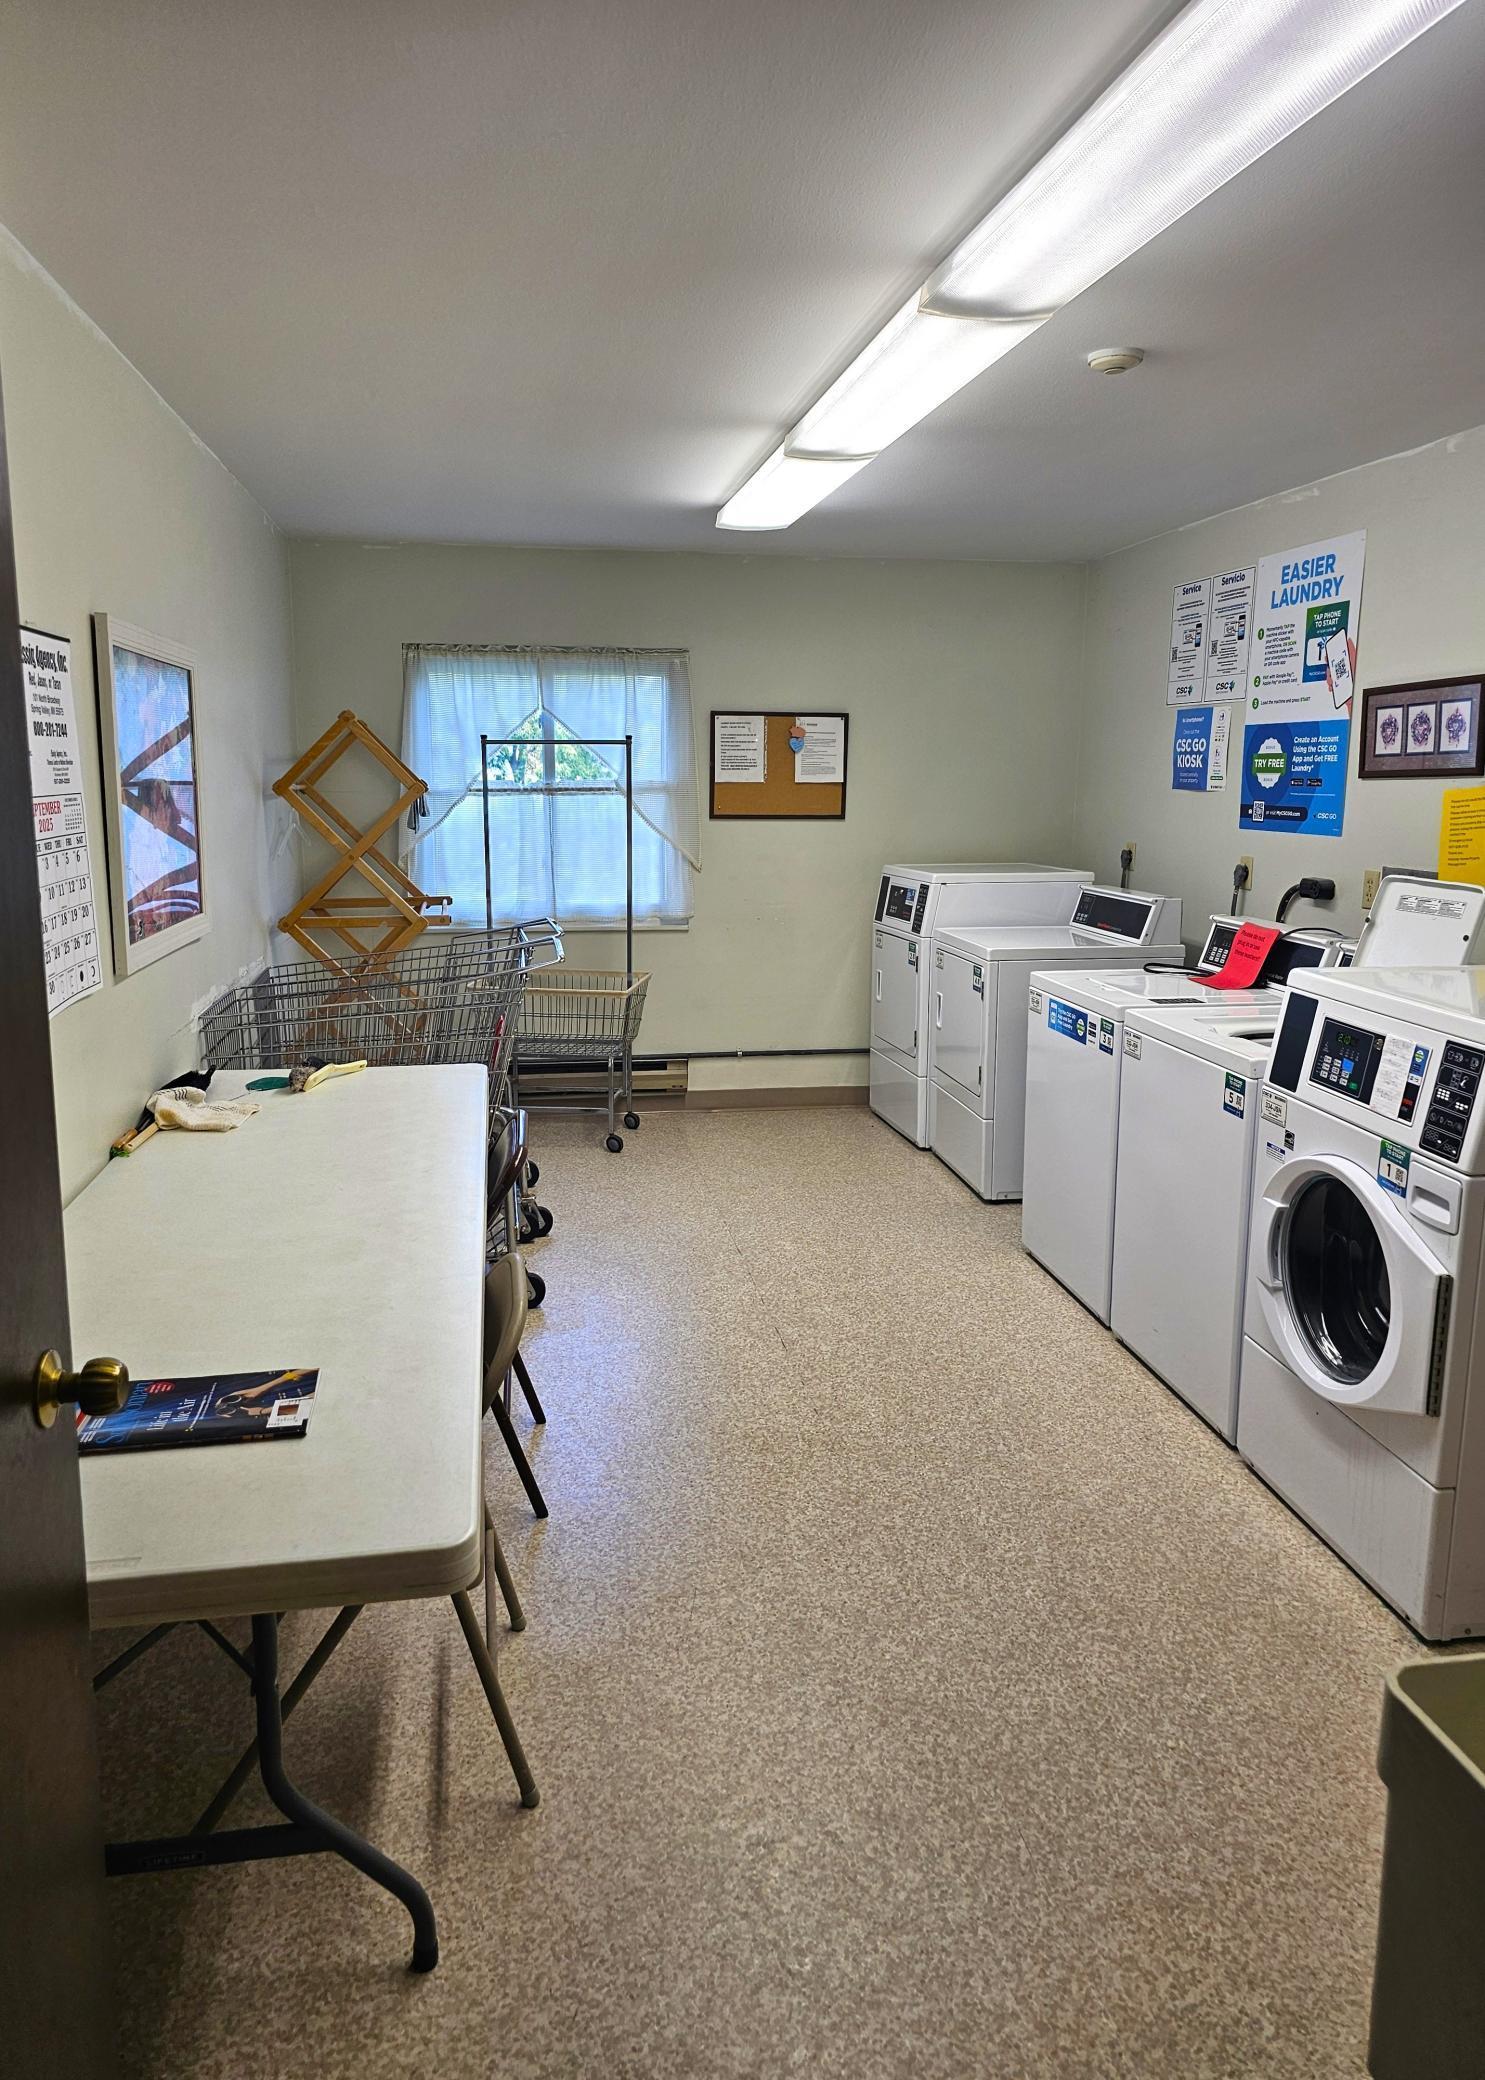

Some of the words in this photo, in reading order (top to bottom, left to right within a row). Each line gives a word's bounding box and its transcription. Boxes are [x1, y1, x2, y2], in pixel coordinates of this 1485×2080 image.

[1281, 553, 1336, 584] EASIER
[1221, 572, 1246, 586] Servicio
[1182, 584, 1202, 596] Service
[1271, 575, 1344, 609] LAUNDRY
[1324, 609, 1341, 619] PHONE
[1315, 620, 1322, 628] TO
[1322, 617, 1339, 626] START
[1176, 686, 1188, 695] CSC
[1216, 682, 1229, 690] CSC
[1176, 738, 1192, 752] CSC
[1192, 738, 1206, 752] GO
[1177, 754, 1203, 768] KIOSK
[1254, 759, 1266, 768] TRY
[1268, 758, 1284, 768] FREE
[39, 818, 53, 832] 2025
[44, 841, 52, 851] WED
[45, 857, 49, 870] 3
[56, 854, 59, 868] 4
[66, 852, 69, 864] 5
[76, 850, 80, 862] 6
[48, 886, 55, 900] 10
[59, 884, 64, 896] 11
[69, 880, 75, 893] 12
[80, 878, 86, 890] 13
[51, 916, 56, 930] 17
[61, 912, 67, 926] 18
[71, 908, 78, 922] 19
[82, 905, 89, 918] 20
[45, 950, 51, 964] 23
[54, 945, 60, 960] 24
[64, 940, 70, 954] 25
[74, 936, 80, 950] 26
[85, 932, 91, 946] 27
[49, 980, 55, 995] 30
[1103, 1034, 1106, 1043] 3
[1229, 1092, 1234, 1104] 5
[1387, 1164, 1391, 1177] 1
[177, 1399, 196, 1410] Air
[172, 1412, 191, 1422] the
